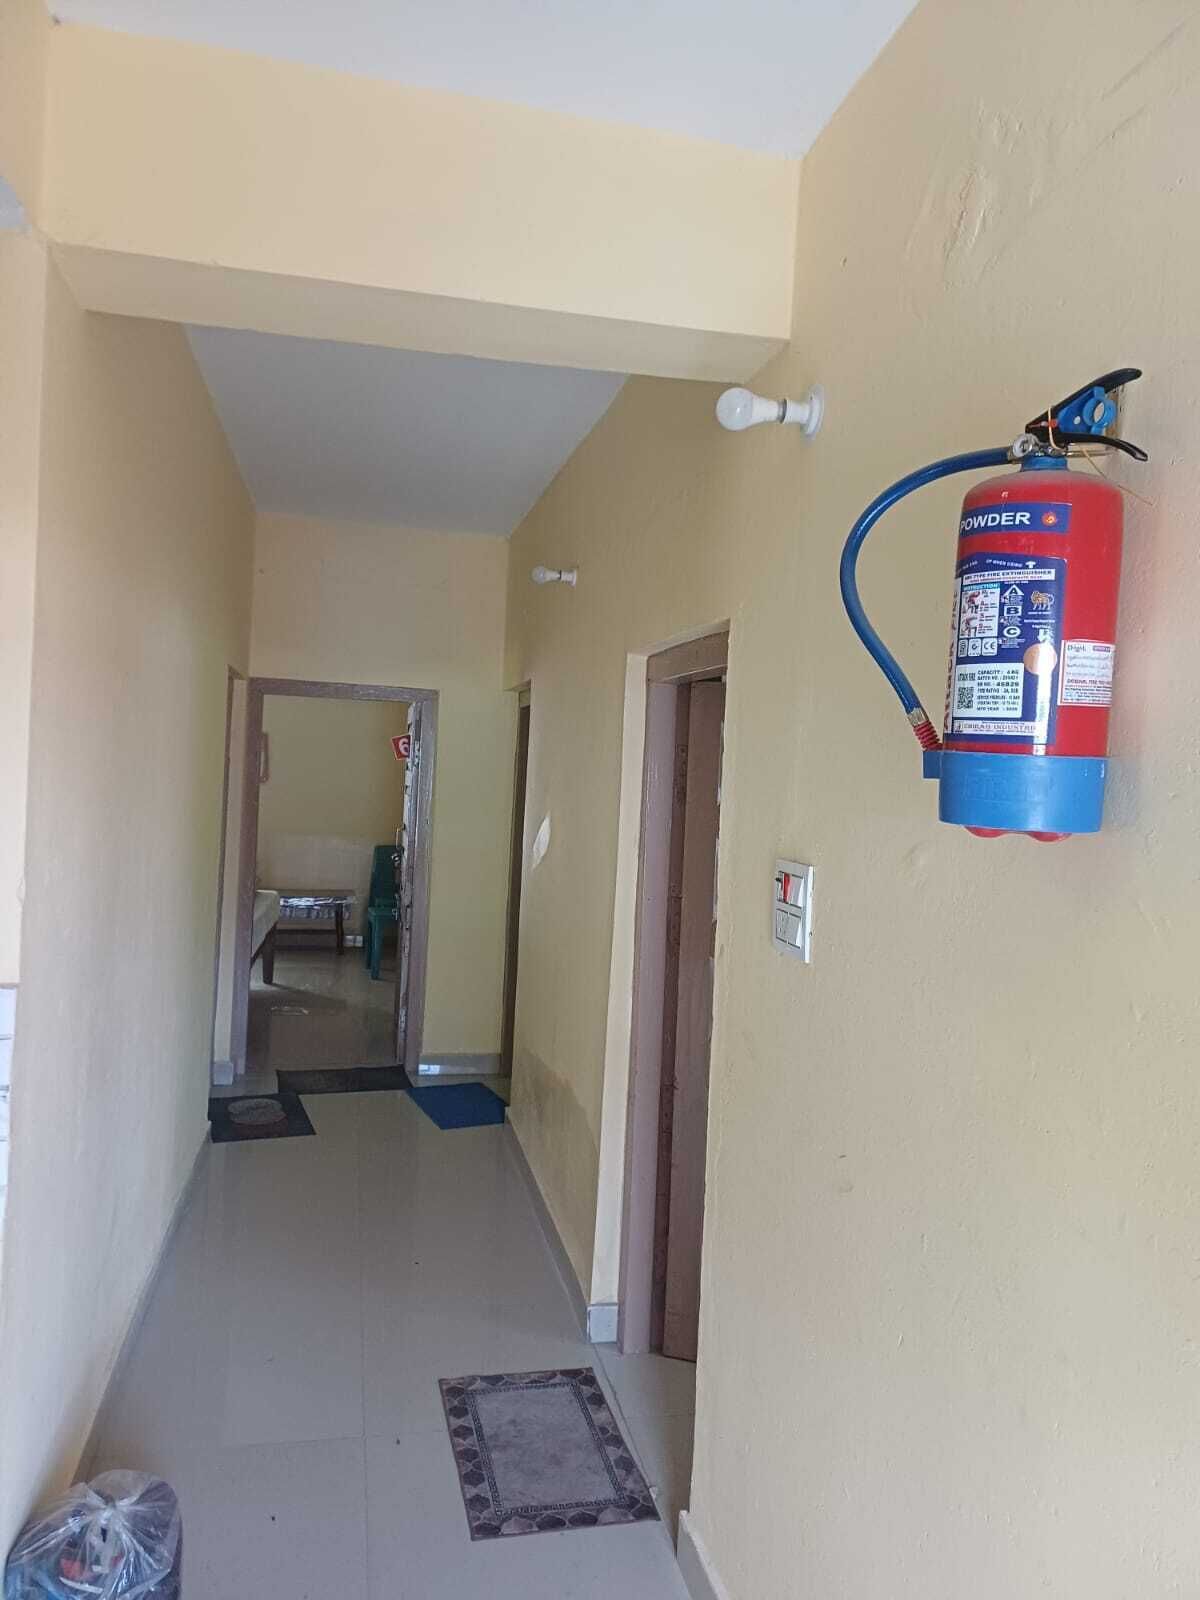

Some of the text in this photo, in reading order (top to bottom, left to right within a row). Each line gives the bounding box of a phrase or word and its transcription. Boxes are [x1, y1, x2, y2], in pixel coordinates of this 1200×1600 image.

[960, 512, 1031, 531] POWDER
[1007, 607, 1020, 615] B
[1007, 628, 1018, 636] C
